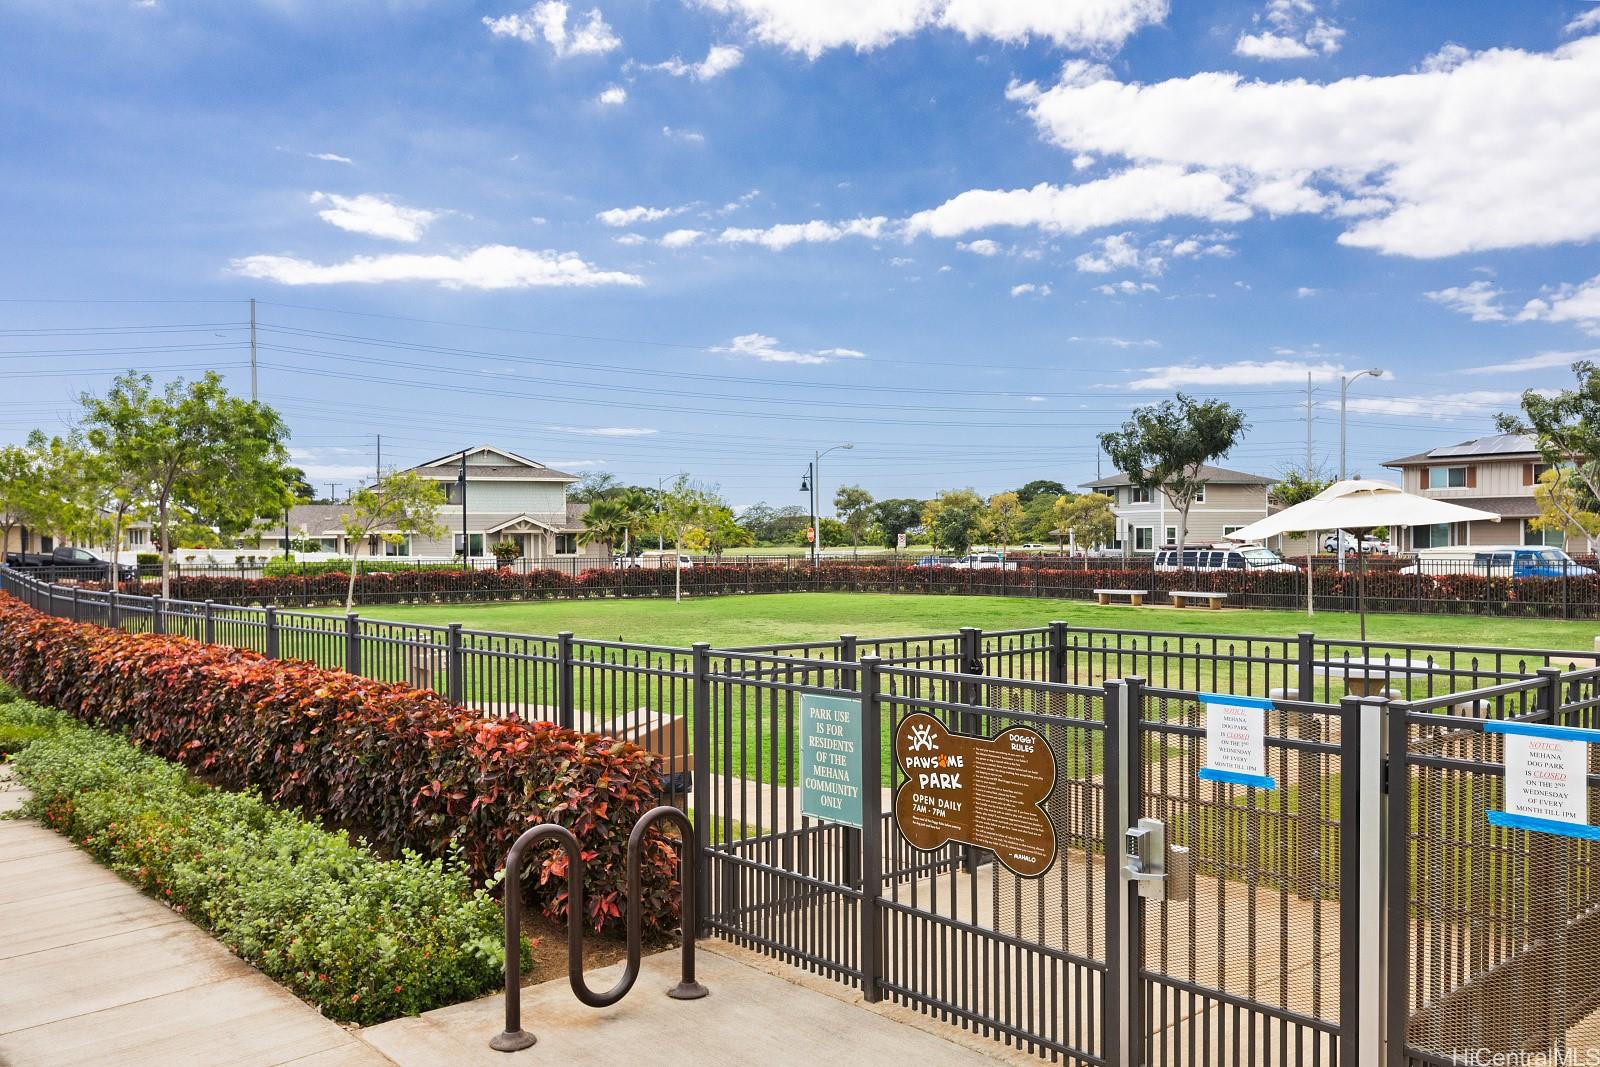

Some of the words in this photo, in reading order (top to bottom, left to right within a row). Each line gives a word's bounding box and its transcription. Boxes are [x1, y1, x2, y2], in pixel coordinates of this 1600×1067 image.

[810, 708, 832, 720] PARK
[834, 710, 850, 722] USE
[816, 722, 824, 733] IS
[826, 724, 843, 736] FOR
[809, 736, 854, 752] RESIDENTS
[1009, 734, 1036, 744] DOGGY
[1012, 743, 1034, 753] RULES
[1219, 747, 1251, 756] WEDNESDAY
[816, 751, 827, 762] OF
[830, 753, 846, 766] THE
[1530, 752, 1562, 760] MEHANA
[814, 765, 850, 782] MEHANA
[1533, 770, 1567, 781] CLOSED
[806, 778, 858, 798] COMMUNITY
[919, 772, 962, 790] PARK
[1523, 788, 1569, 799] WEDNESDAY
[820, 794, 842, 810] ONLY
[912, 794, 934, 806] OPEN
[938, 798, 962, 812] DAILY
[1539, 799, 1564, 808] EVERY
[912, 804, 926, 814] 7AM
[932, 808, 946, 818] 7PM
[1516, 805, 1543, 813] MONTH
[1544, 808, 1560, 816] TILL
[1562, 810, 1576, 818] 1PM
[1014, 854, 1036, 863] MAHALO
